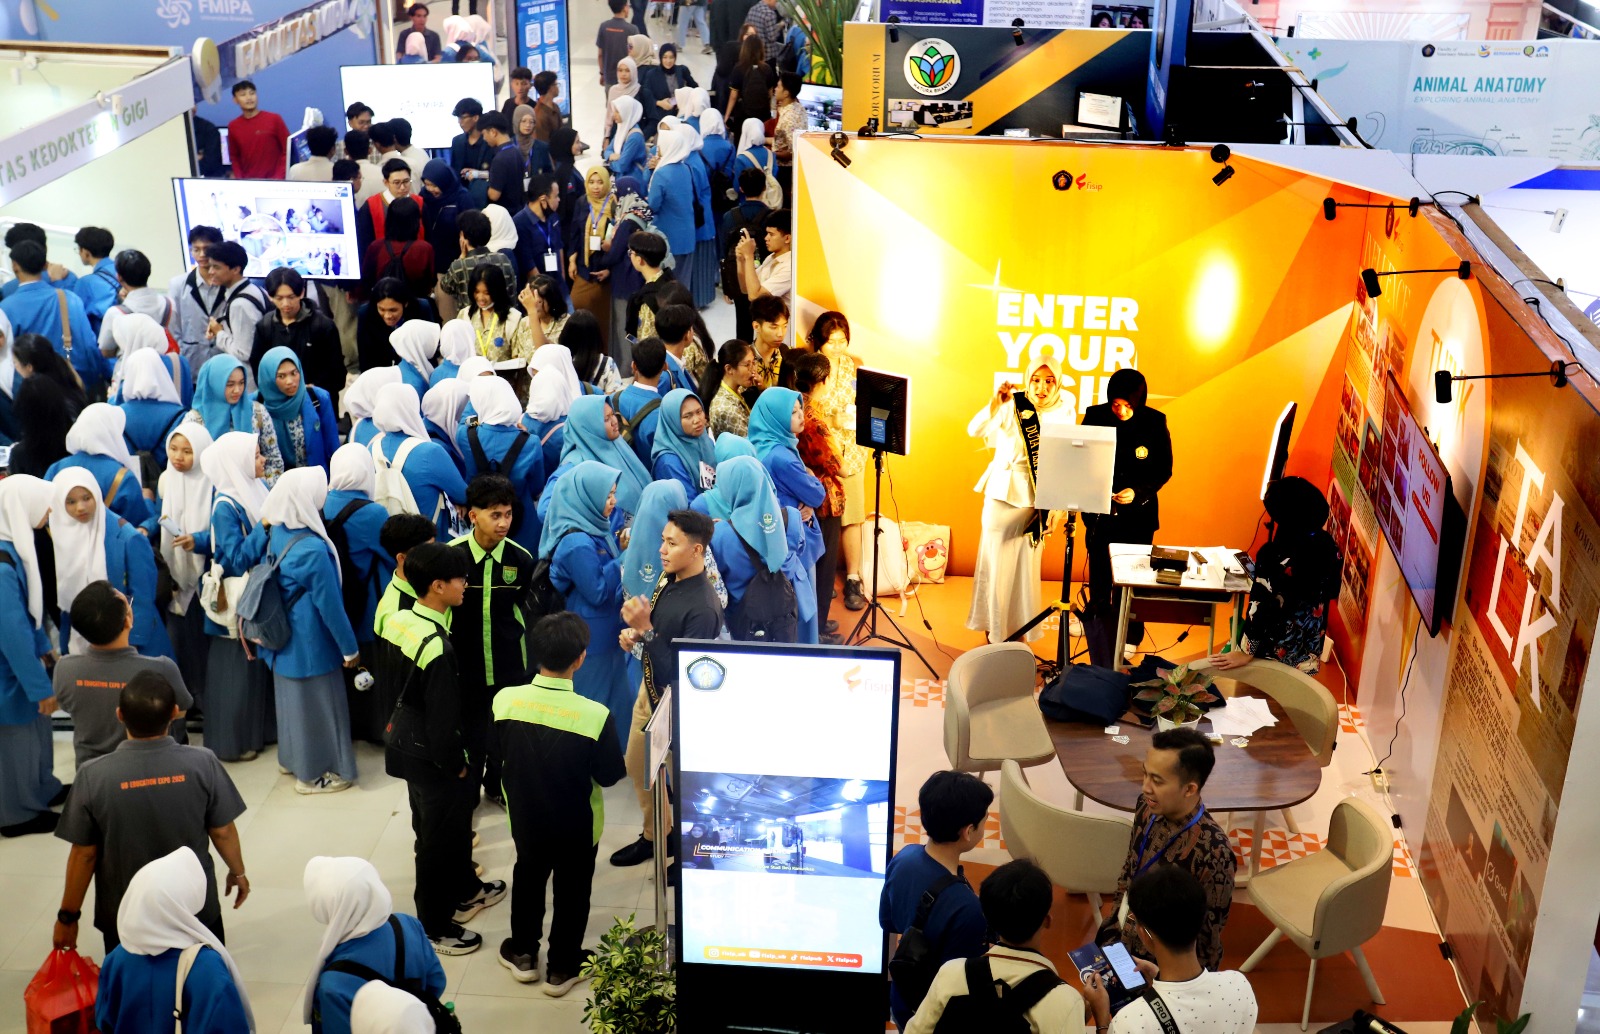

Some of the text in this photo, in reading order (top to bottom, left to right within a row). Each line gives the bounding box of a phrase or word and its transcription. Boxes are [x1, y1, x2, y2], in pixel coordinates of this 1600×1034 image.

[236, 12, 317, 78] FAKULTAS
[1413, 76, 1547, 93] ANIMAL ANATOMY
[1413, 96, 1540, 104] EXPLORING ANIMAL ANATOMY
[29, 114, 119, 171] KEDOKTEN
[122, 98, 149, 127] GIGI
[1086, 181, 1103, 192] fisip
[996, 292, 1139, 332] ENTER
[996, 331, 1138, 373] YOUR
[1419, 447, 1440, 494] FOLLOW
[1574, 521, 1600, 567] KOMPAS
[84, 680, 108, 688] EDUCATION
[109, 681, 121, 689] EXPO
[864, 678, 893, 694] fisip
[120, 781, 129, 790] UB
[130, 778, 157, 789] EDUCATION
[158, 776, 171, 785] EXPO
[700, 844, 761, 854] COMMUNICATION
[1494, 874, 1508, 903] Grok
[1153, 1001, 1167, 1019] PRO
